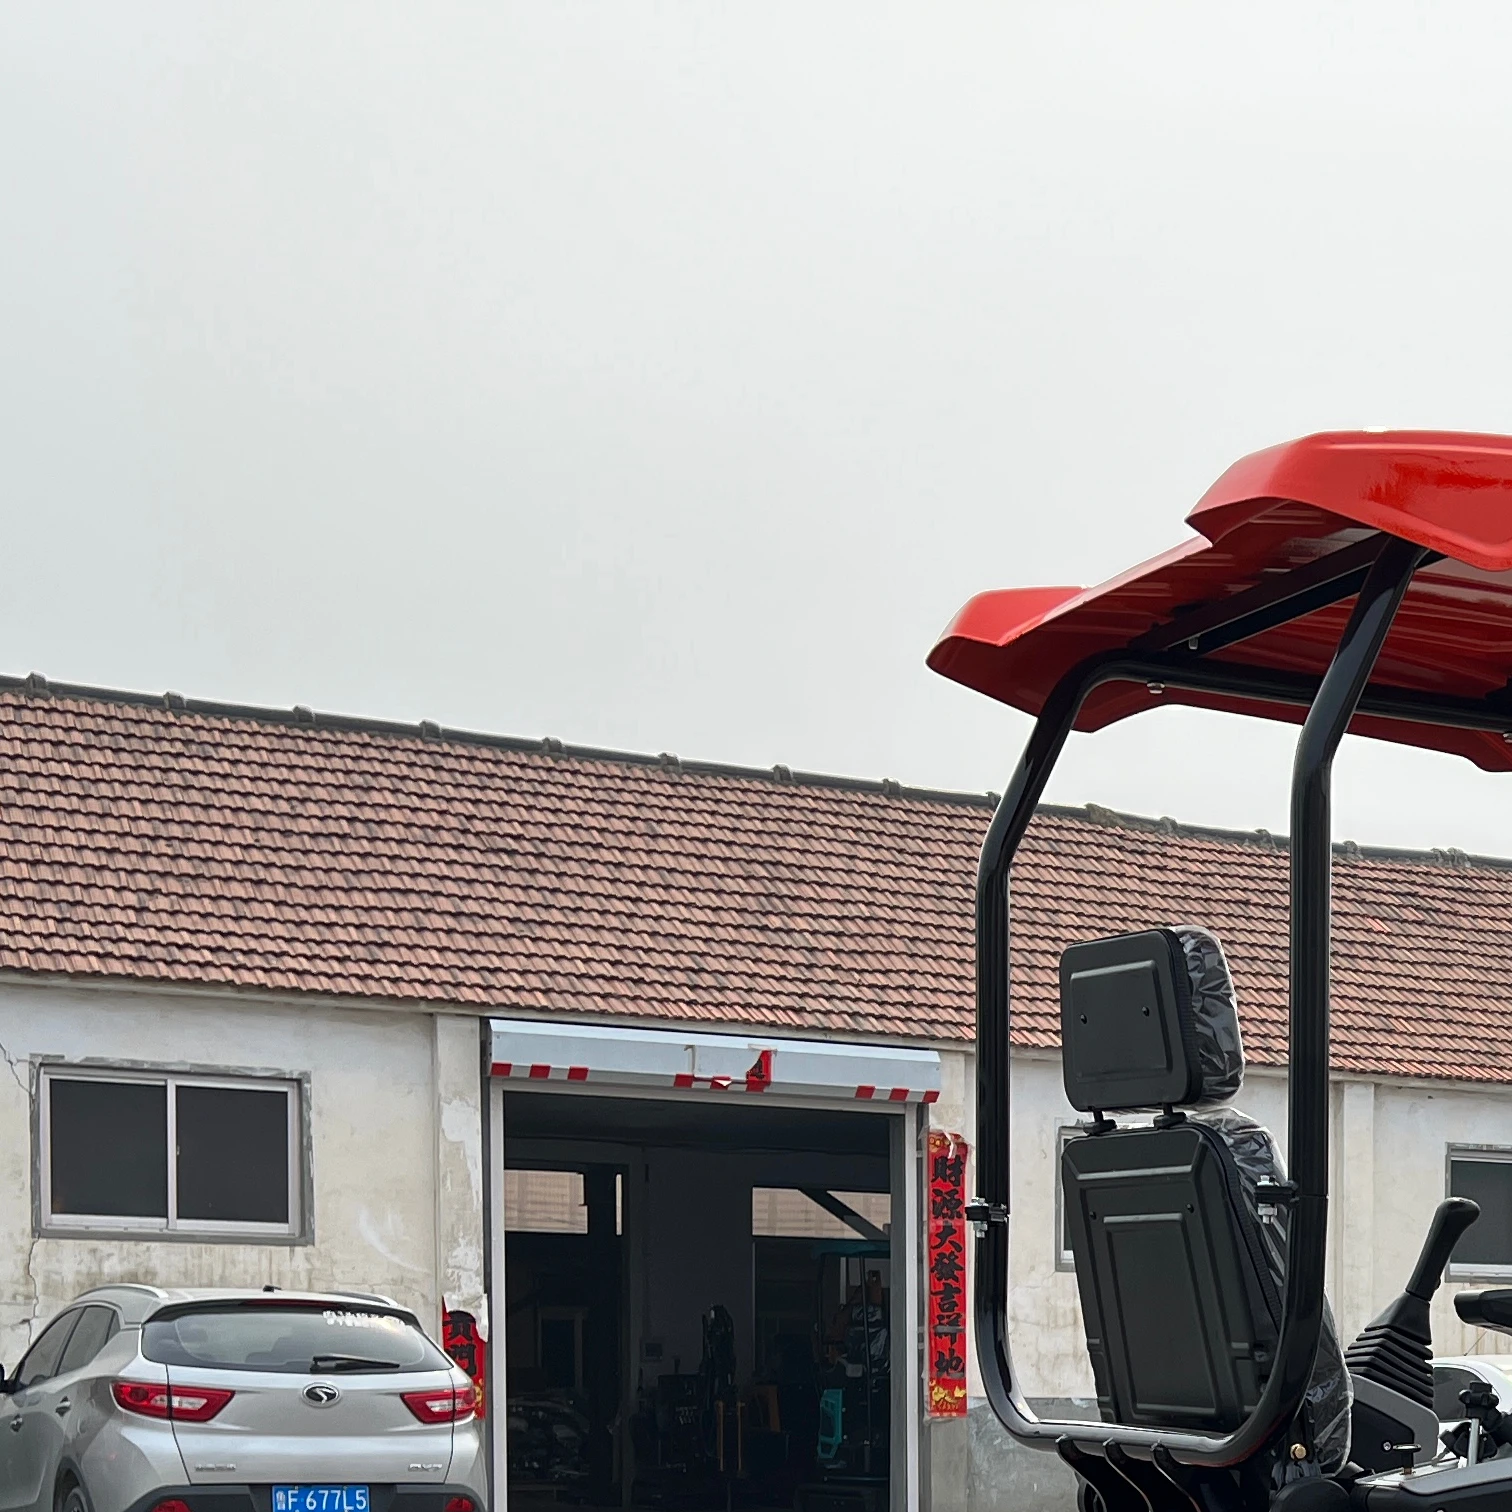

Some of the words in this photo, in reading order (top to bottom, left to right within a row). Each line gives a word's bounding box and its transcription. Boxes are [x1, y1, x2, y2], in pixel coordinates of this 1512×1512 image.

[930, 1154, 965, 1379] 財源大發吉祥地
